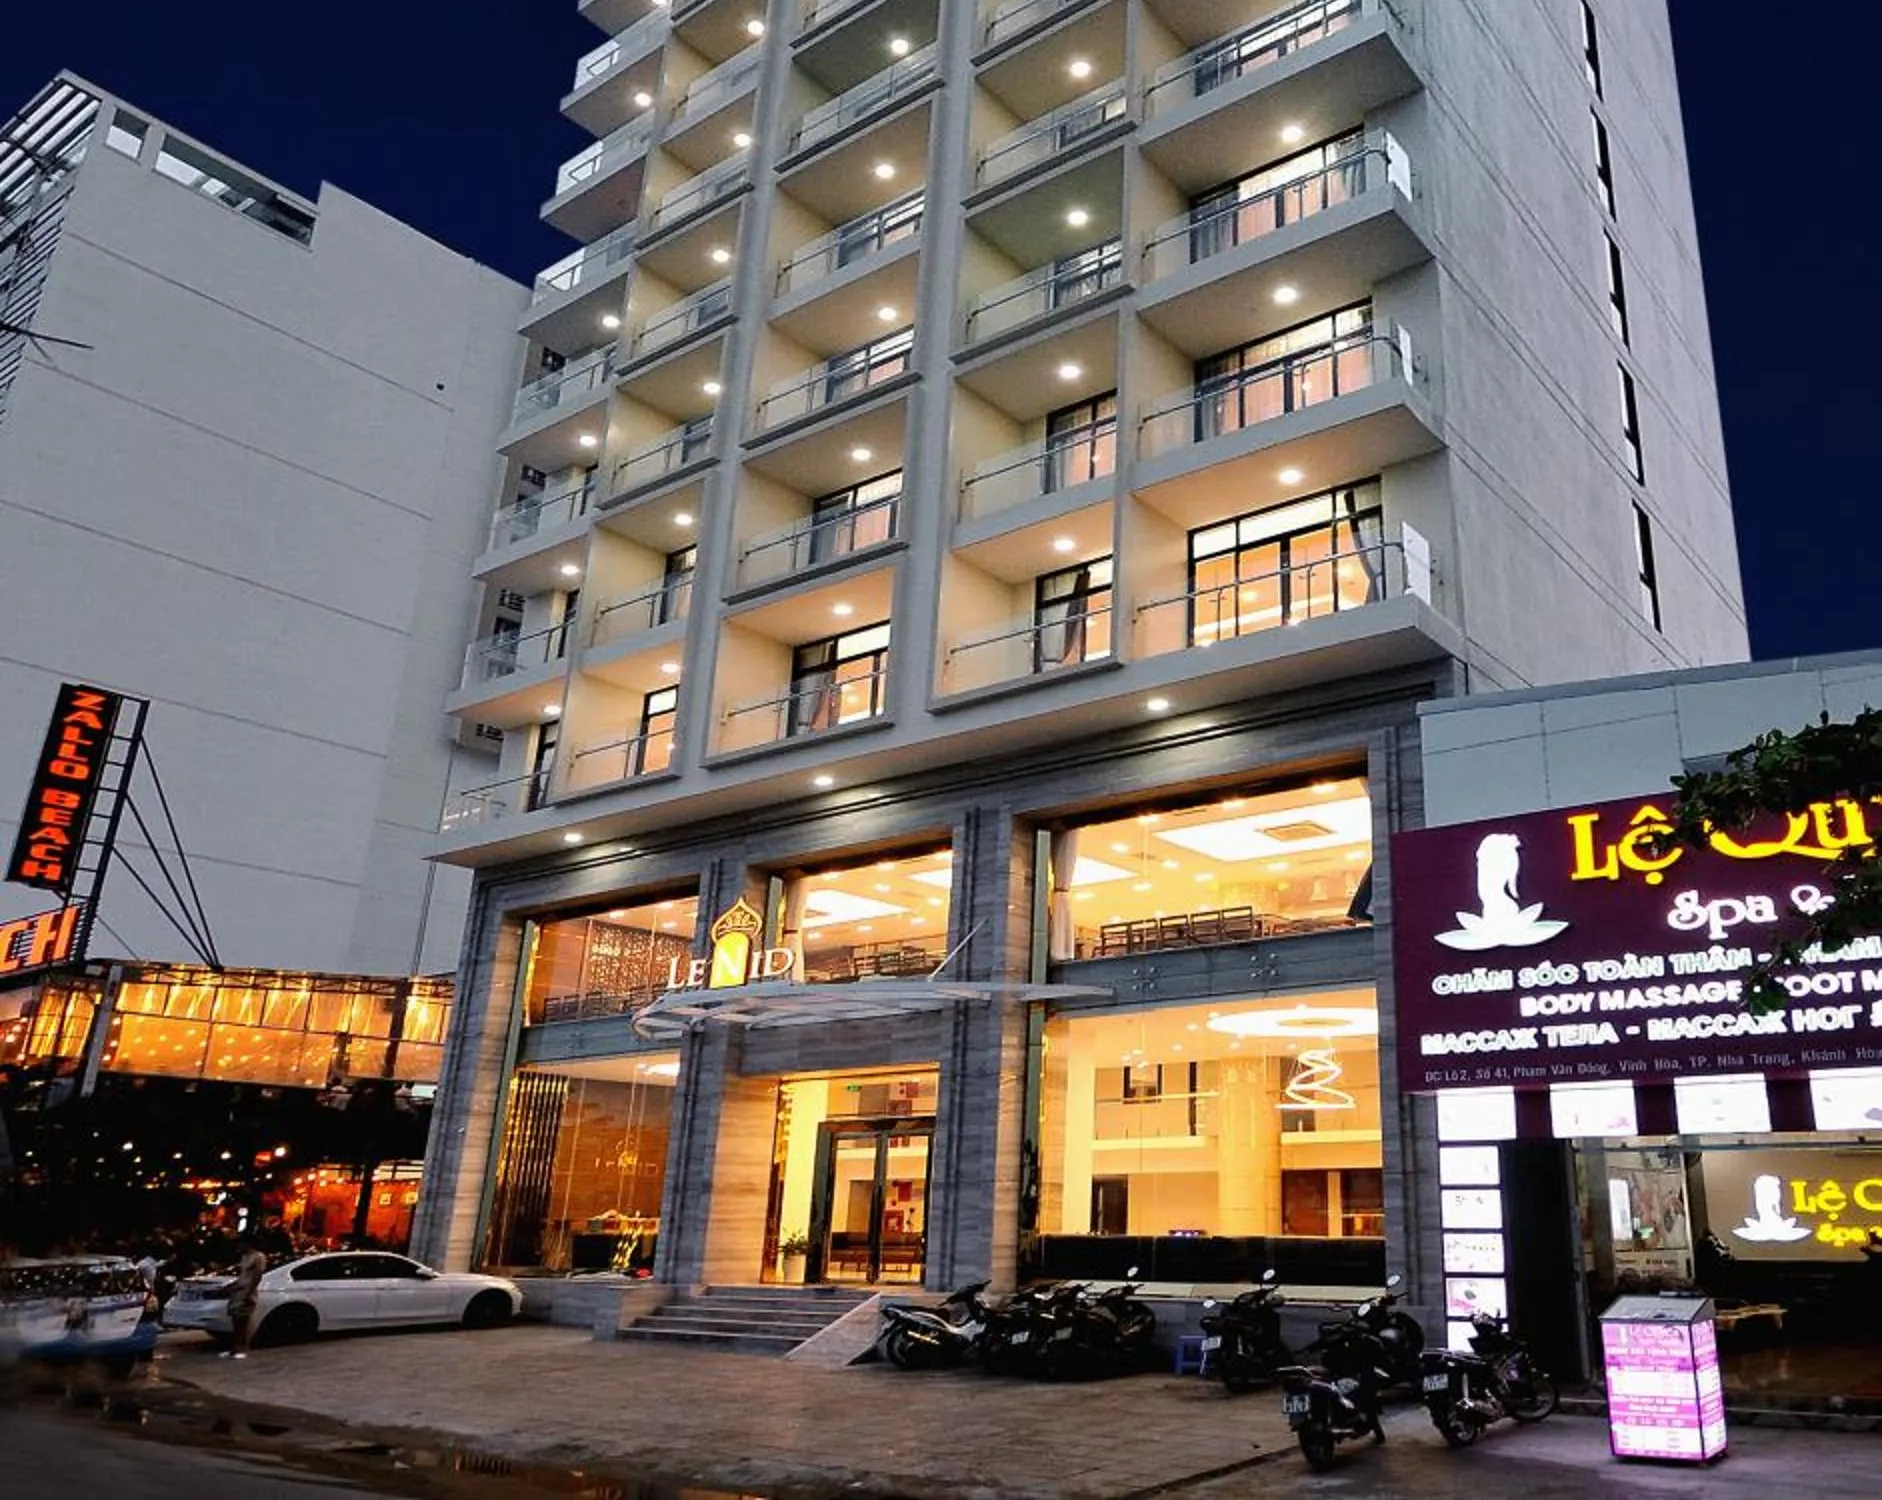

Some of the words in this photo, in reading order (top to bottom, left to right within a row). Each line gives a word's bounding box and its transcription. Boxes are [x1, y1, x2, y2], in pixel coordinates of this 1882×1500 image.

[48, 690, 108, 781] ZALLO
[21, 787, 81, 882] BEACH
[1667, 888, 1778, 940] Spa
[1519, 992, 1595, 1017] BODY
[1599, 979, 1742, 1011] MASSAGE
[1774, 971, 1856, 997] OOT
[1789, 1179, 1848, 1221] Lệ
